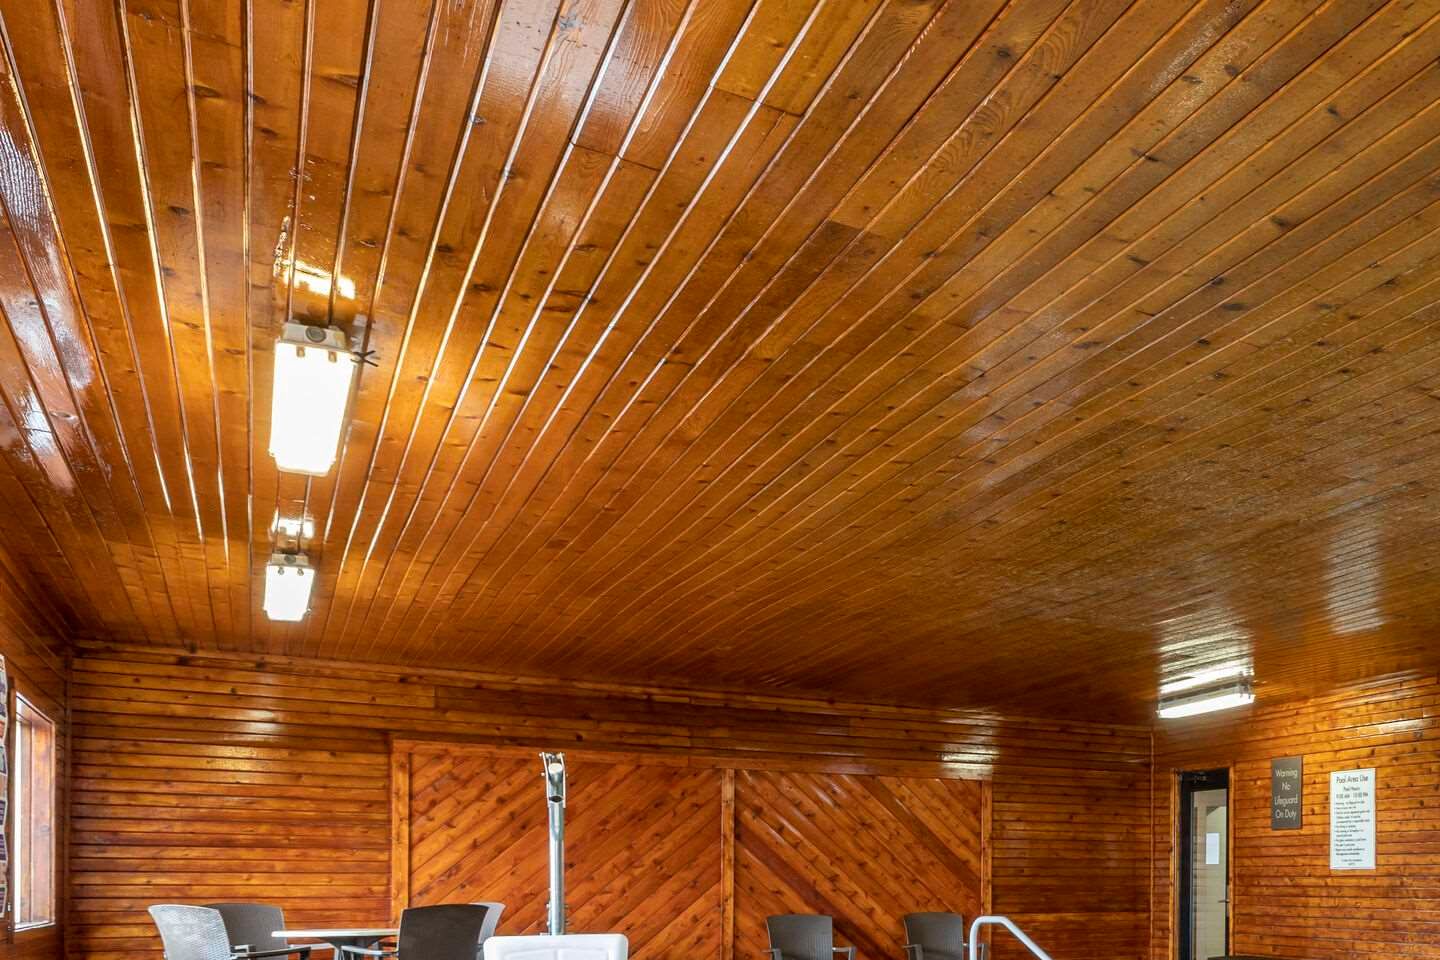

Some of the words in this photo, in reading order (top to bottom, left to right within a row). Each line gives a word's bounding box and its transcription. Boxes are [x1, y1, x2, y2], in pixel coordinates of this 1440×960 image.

[1275, 768, 1298, 778] Warning
[1336, 775, 1346, 783] Pool
[1281, 782, 1291, 790] No
[1274, 794, 1298, 807] Lifeguard
[1275, 809, 1284, 818] On
[1285, 808, 1297, 820] Duty
